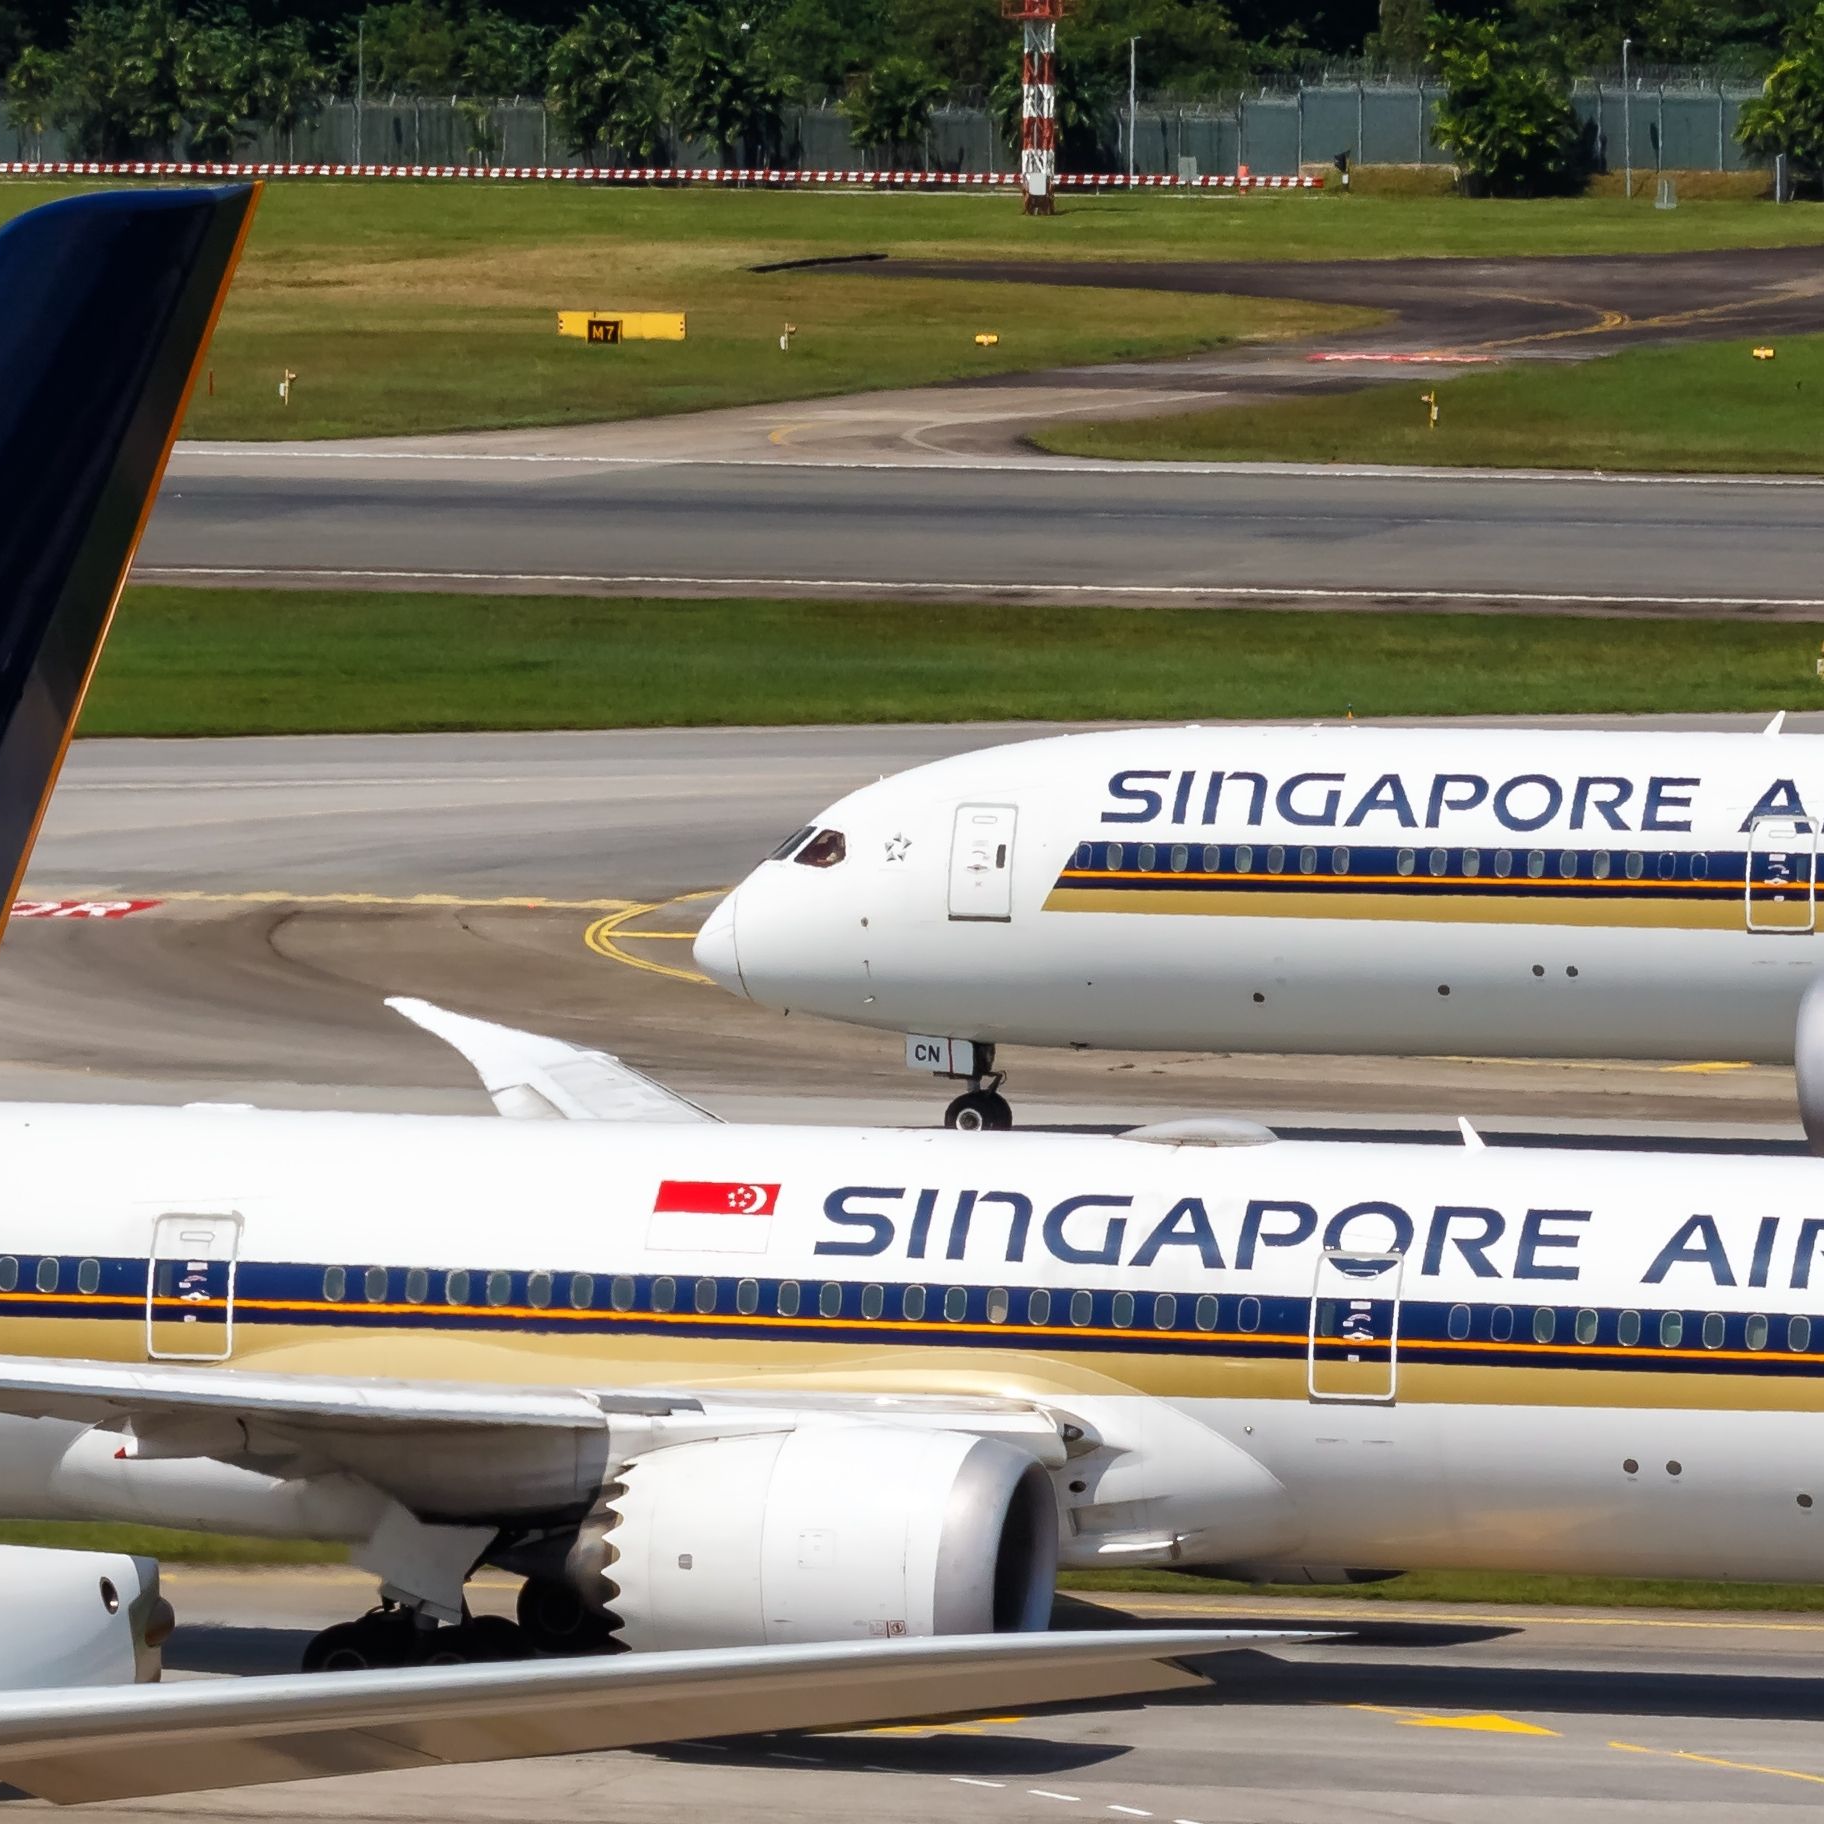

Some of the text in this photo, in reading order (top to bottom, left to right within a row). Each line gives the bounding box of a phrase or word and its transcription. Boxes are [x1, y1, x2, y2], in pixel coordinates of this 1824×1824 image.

[591, 324, 615, 340] M7
[1100, 770, 1701, 832] SINGAPORE
[914, 1043, 941, 1062] CN
[813, 1186, 1593, 1281] SINGAPORE
